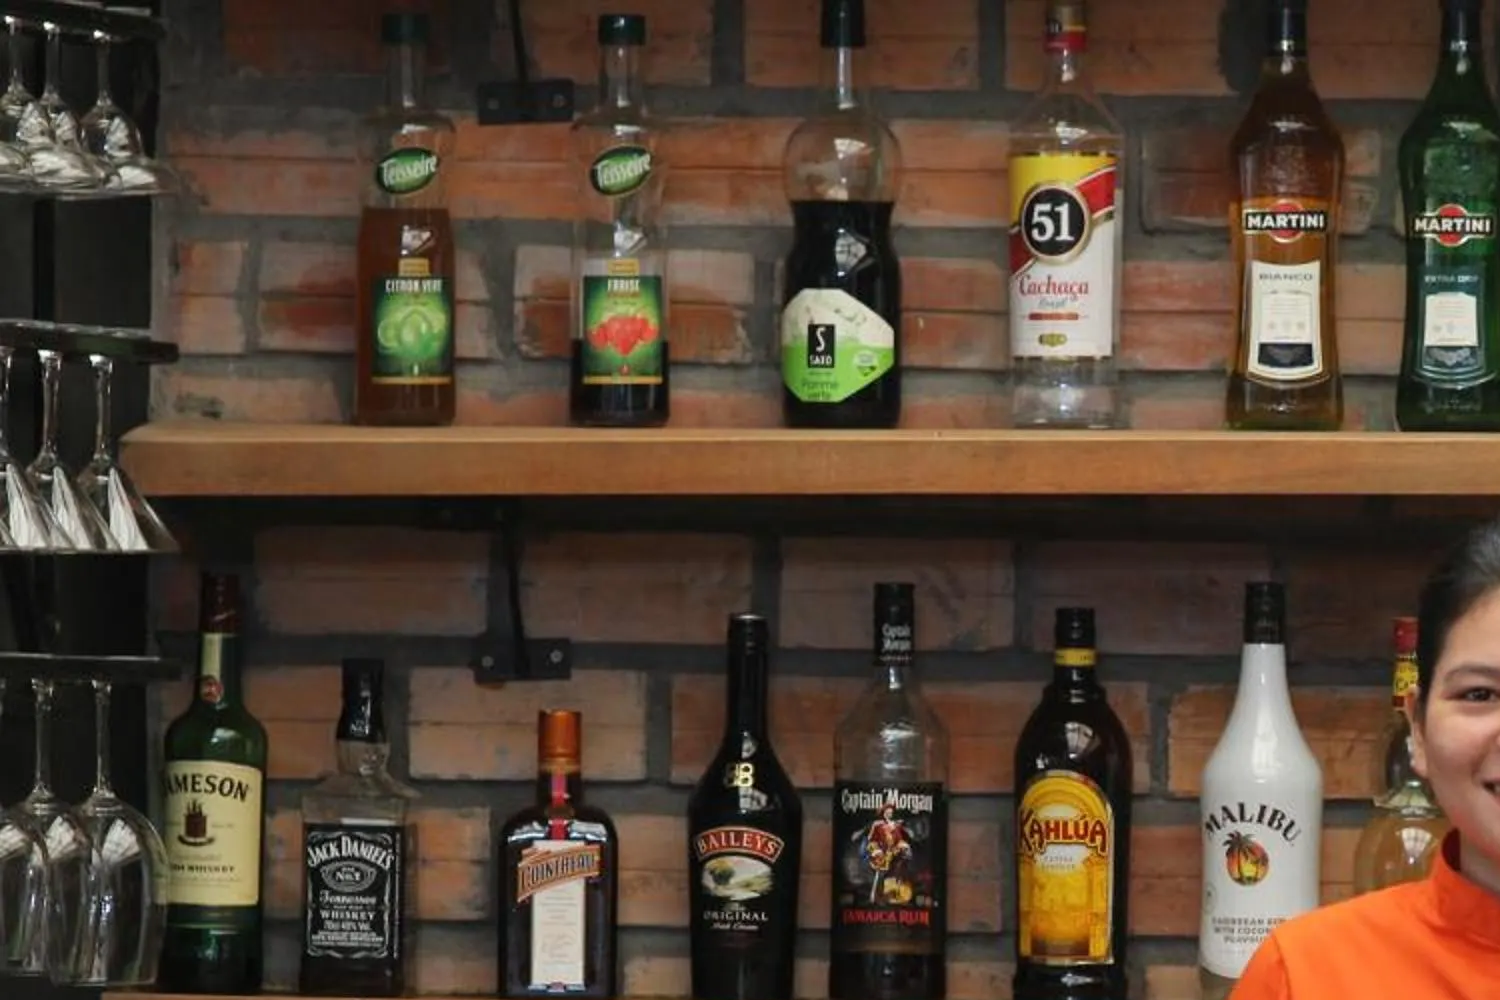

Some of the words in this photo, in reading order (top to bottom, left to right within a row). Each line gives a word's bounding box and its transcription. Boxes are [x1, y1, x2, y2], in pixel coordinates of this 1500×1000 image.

[380, 154, 437, 187] Teisseire
[594, 153, 651, 188] Teisseire
[1030, 202, 1075, 242] 51
[1247, 214, 1325, 229] MARTINI
[1414, 218, 1491, 233] MARTINI
[385, 279, 419, 293] CITRON
[607, 279, 640, 292] FRAISE
[1018, 273, 1089, 301] Cachaça
[163, 773, 250, 802] AMESON
[842, 788, 883, 814] Captain
[886, 788, 934, 814] Morgan
[1019, 809, 1108, 853] KAHLÚA
[1205, 802, 1303, 843] MALIBU
[308, 840, 341, 868] JACK
[341, 835, 395, 871] DANIEL'S
[698, 831, 778, 856] BAILEYS
[521, 855, 595, 890] COINTREAU
[320, 911, 376, 920] WHISKEY
